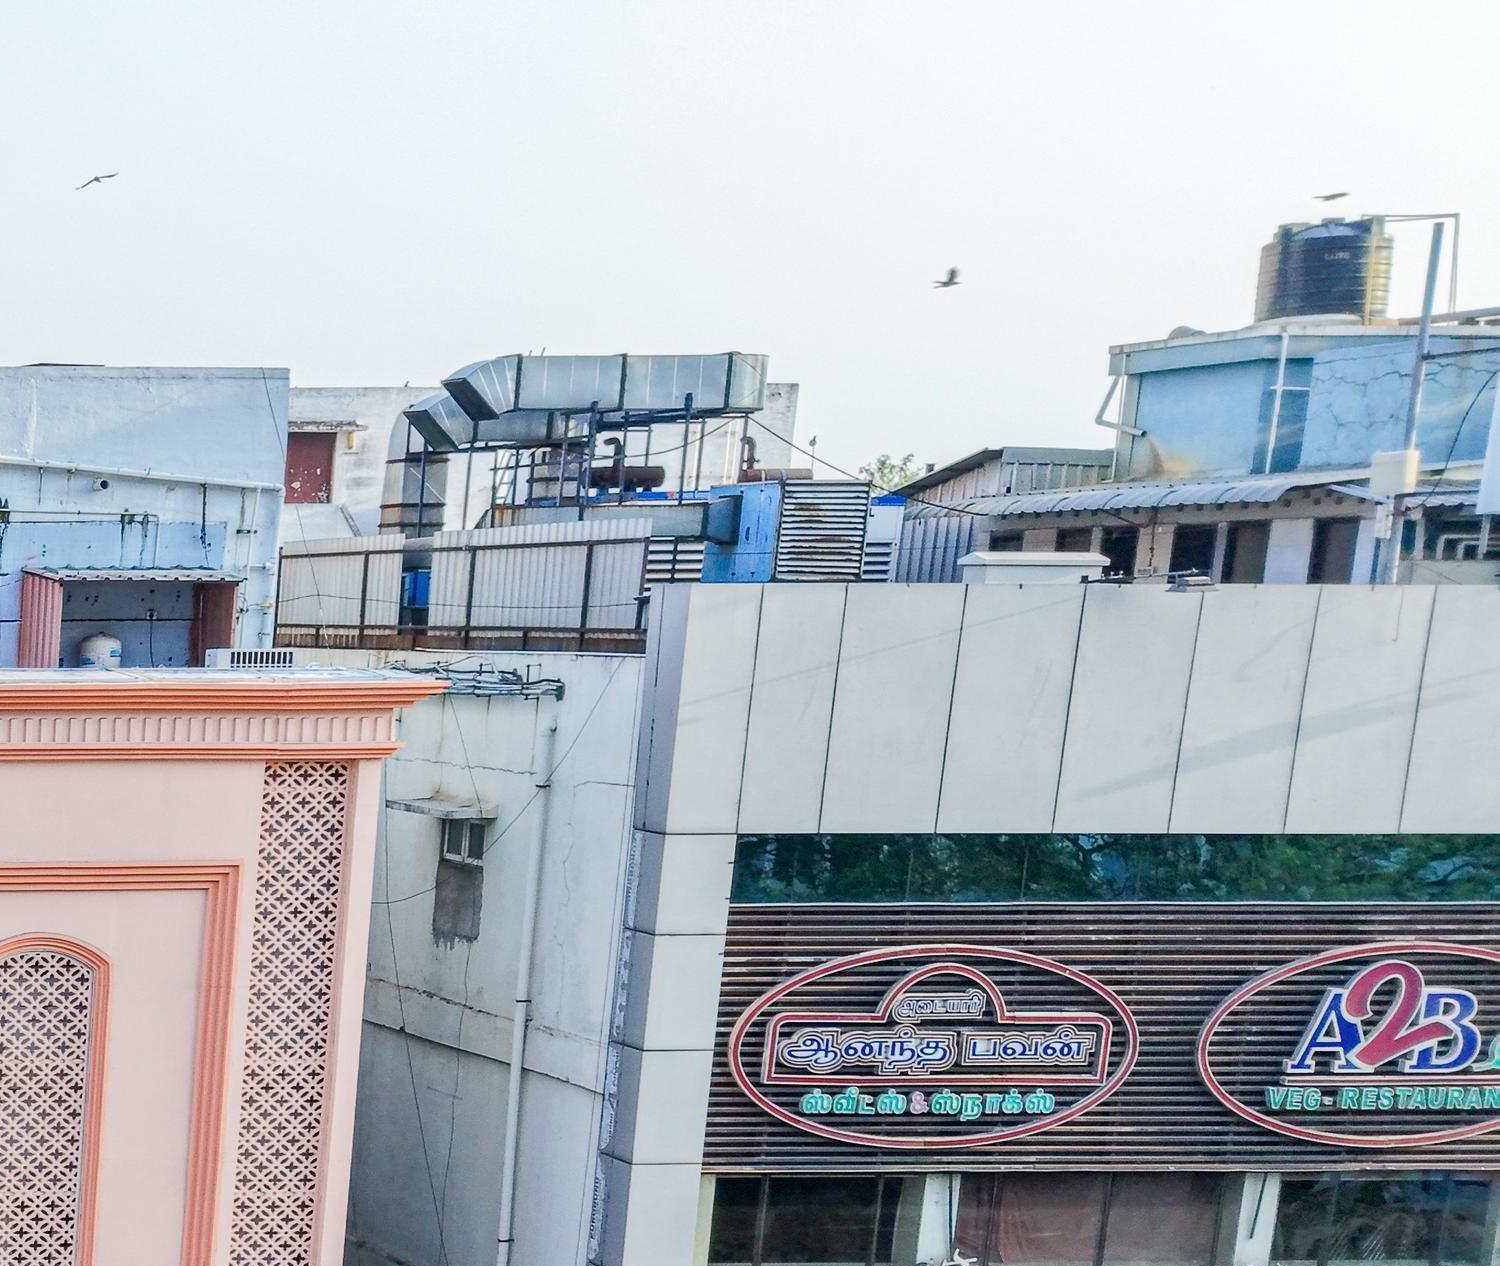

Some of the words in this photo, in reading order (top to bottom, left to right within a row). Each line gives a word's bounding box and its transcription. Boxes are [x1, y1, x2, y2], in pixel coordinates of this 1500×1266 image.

[782, 1027, 956, 1072] ஆனந்த
[963, 1027, 1092, 1064] பவன்
[1283, 959, 1482, 1073] A2B
